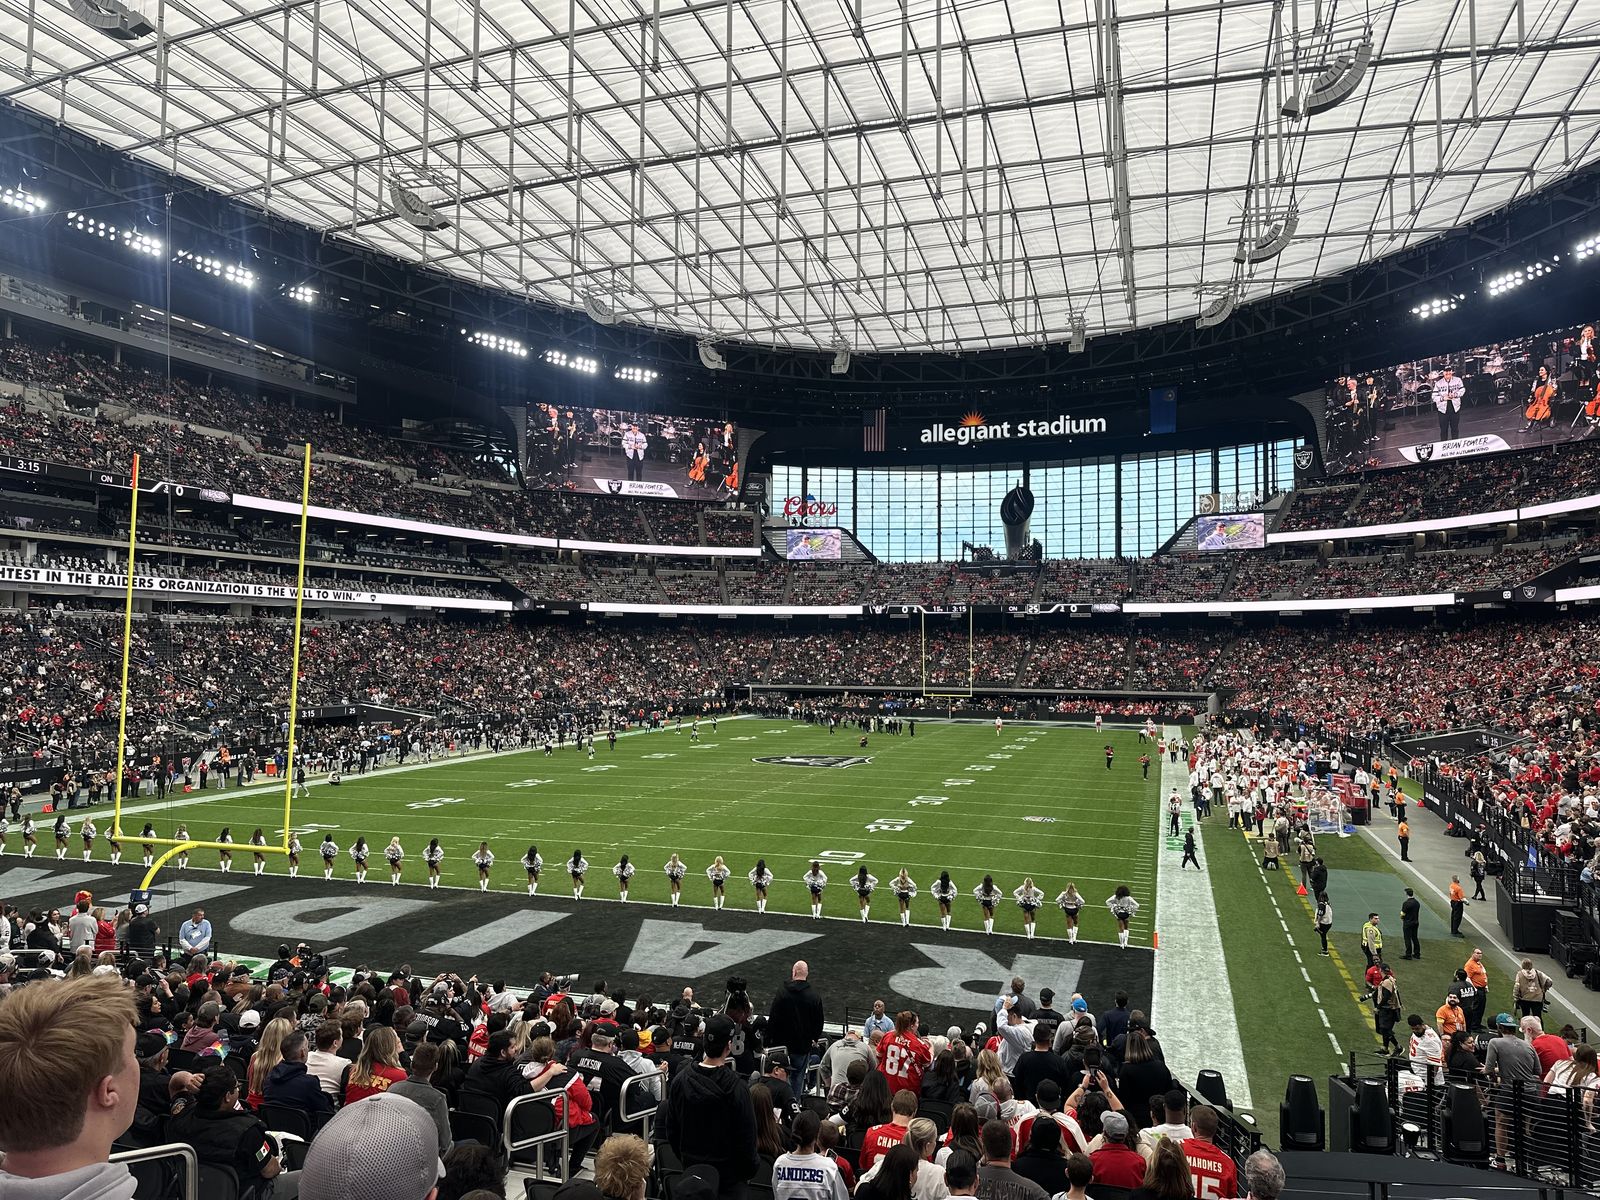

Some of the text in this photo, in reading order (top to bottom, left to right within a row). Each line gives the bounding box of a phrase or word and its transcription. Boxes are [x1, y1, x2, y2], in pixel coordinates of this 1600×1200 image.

[920, 415, 1106, 445] allegiant stadium
[17, 460, 40, 472] 3:15
[101, 475, 113, 483] ON
[175, 485, 184, 496] 0
[1222, 491, 1263, 504] MGM
[784, 496, 837, 515] Coors
[46, 571, 61, 582] IN
[67, 572, 92, 584] THE
[98, 575, 153, 588] RAIDERS
[159, 579, 249, 594] ORGANIZATION
[254, 586, 263, 595] IS
[267, 587, 285, 596] THE
[316, 590, 328, 599] TO
[301, 710, 315, 718] 3:15
[578, 1058, 602, 1071] JACKSON
[1186, 1155, 1222, 1173] MAHOMES
[777, 1167, 824, 1183] SANDERS
